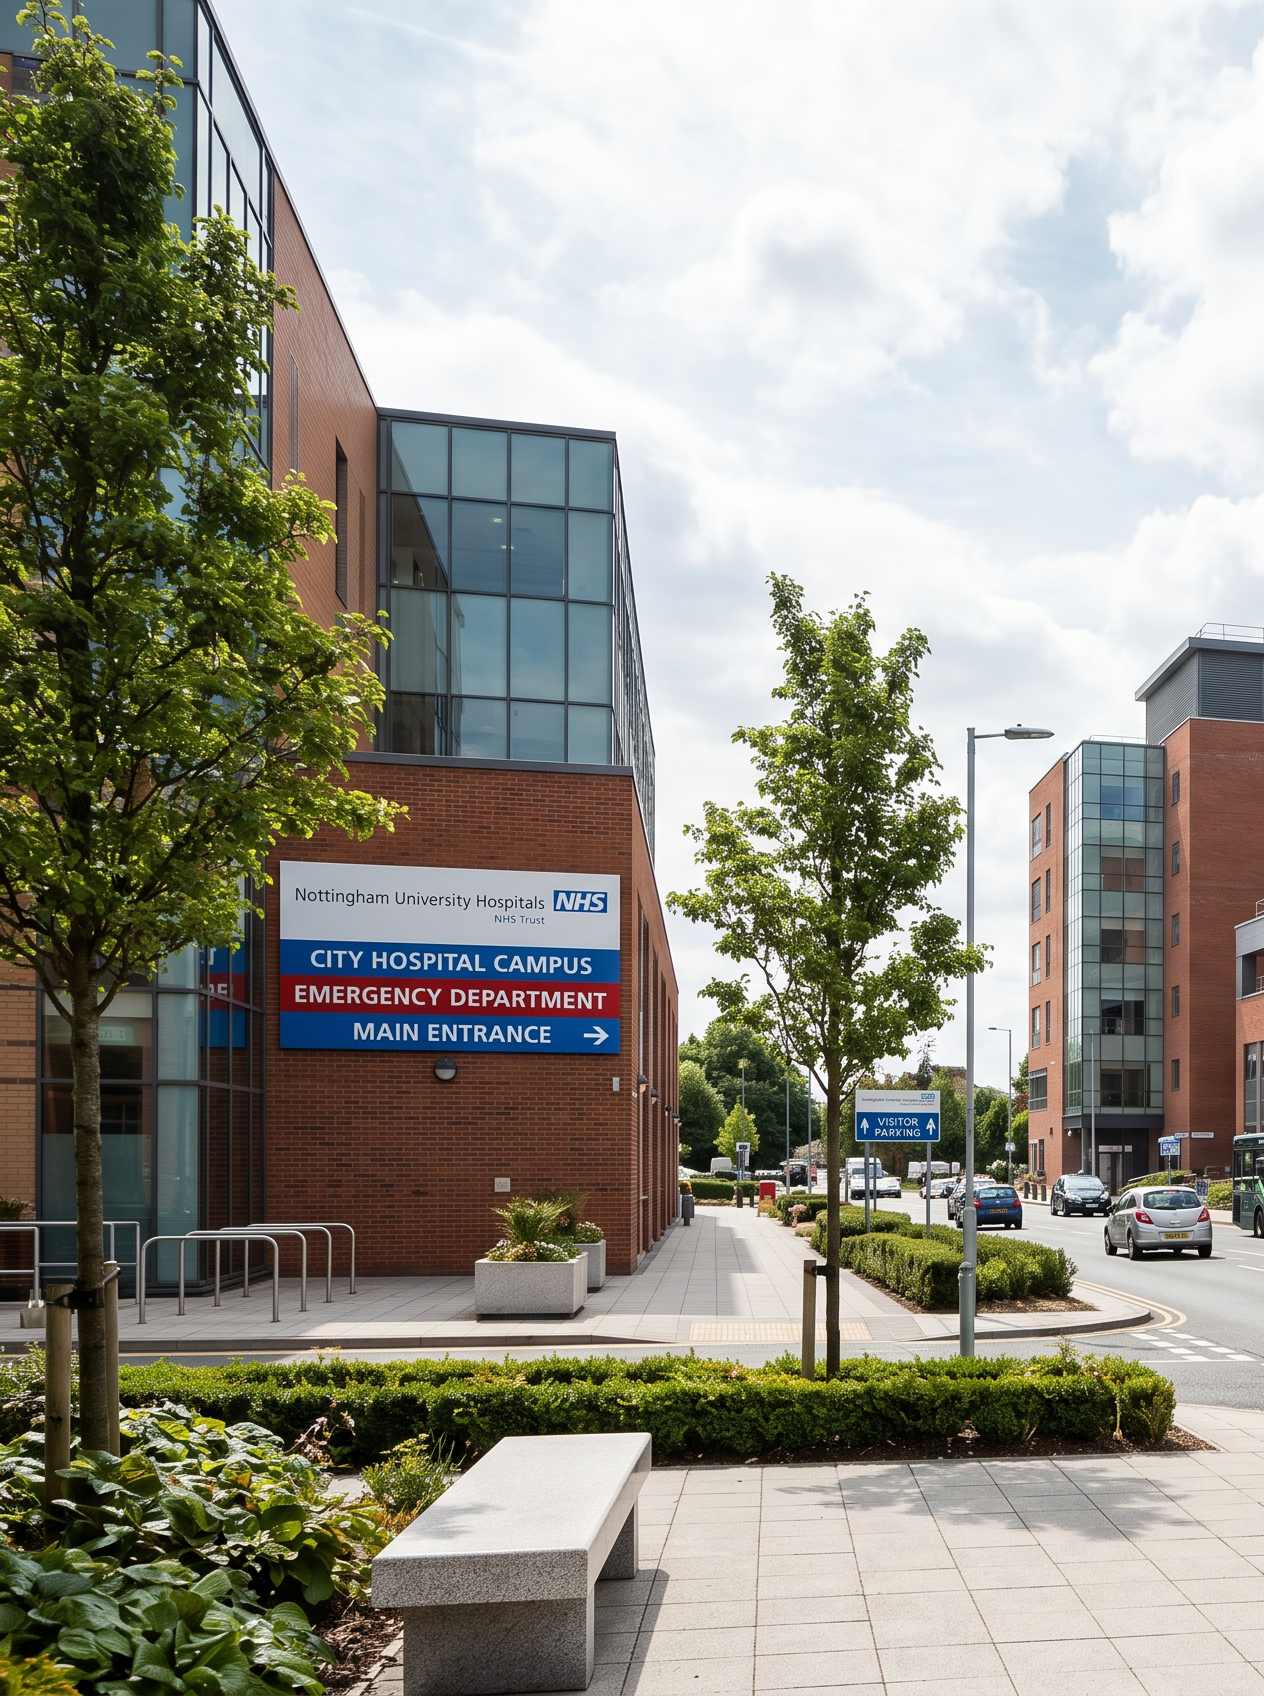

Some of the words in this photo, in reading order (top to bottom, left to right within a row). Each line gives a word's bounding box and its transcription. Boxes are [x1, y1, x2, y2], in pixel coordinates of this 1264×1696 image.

[295, 887, 389, 907] Nottingham
[395, 891, 471, 911] University
[476, 895, 545, 912] Hospitals
[555, 892, 605, 912] NHS
[494, 915, 517, 924] NHS
[519, 915, 545, 925] Trust
[310, 950, 364, 969] CITY
[372, 951, 486, 972] HOSPITAL
[493, 954, 593, 975] CAMPUS
[294, 985, 442, 1006] EMERGENCY
[450, 988, 607, 1010] DEPARTMENT
[353, 1022, 419, 1041] MAIN
[428, 1023, 552, 1044] ENTRANCE
[877, 1117, 919, 1127] VISITOR
